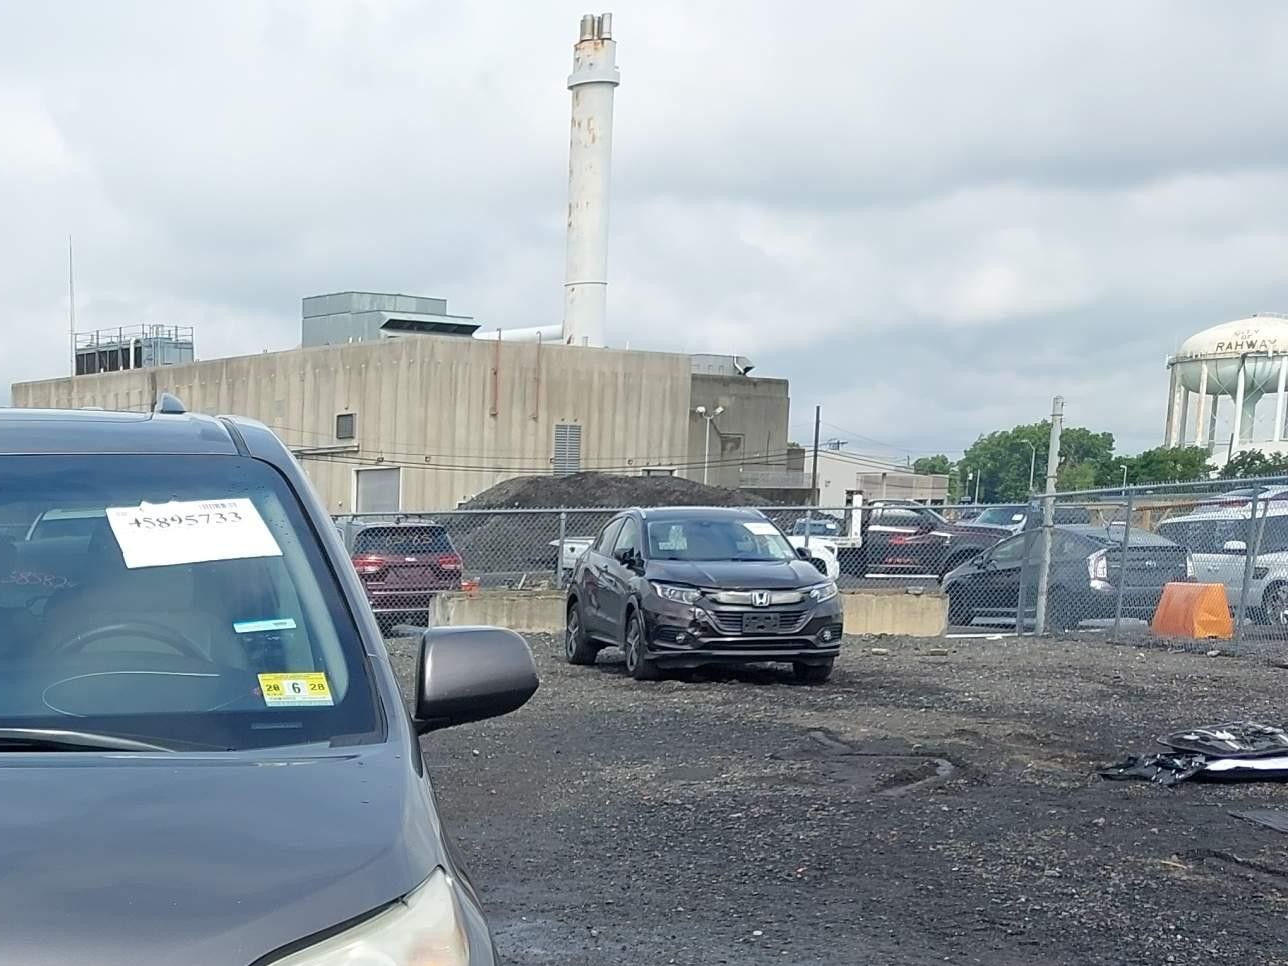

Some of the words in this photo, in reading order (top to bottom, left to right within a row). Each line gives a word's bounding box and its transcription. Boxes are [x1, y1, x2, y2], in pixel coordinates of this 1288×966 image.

[1216, 339, 1277, 351] RAHWAY
[129, 511, 242, 529] 45895733
[292, 682, 301, 694] 6
